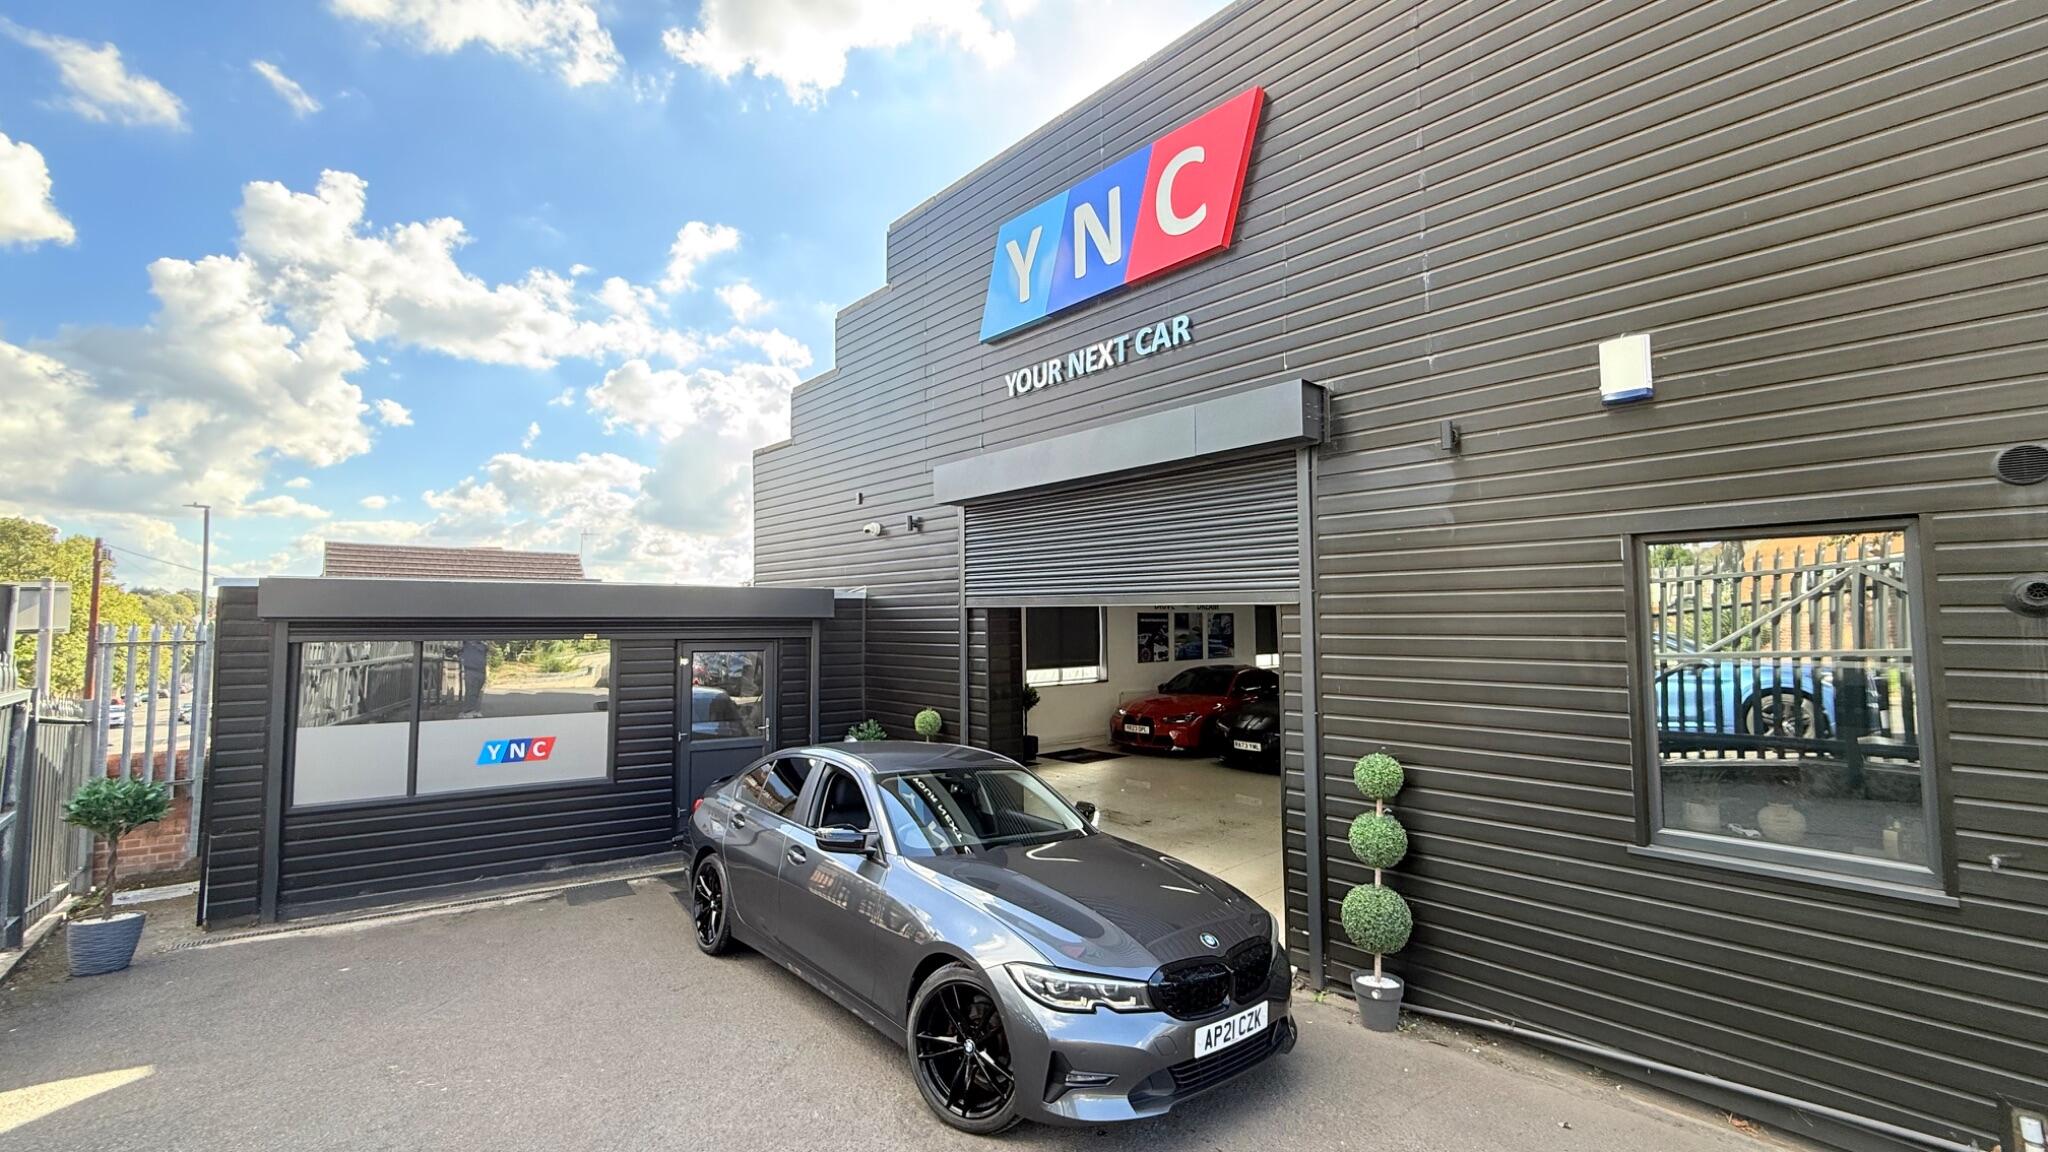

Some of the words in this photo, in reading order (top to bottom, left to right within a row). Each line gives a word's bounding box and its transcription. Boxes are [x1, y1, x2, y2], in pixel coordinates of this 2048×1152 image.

[1005, 146, 1207, 303] YNC
[1004, 358, 1062, 397] YOUR
[1067, 334, 1130, 378] NEXT
[1134, 315, 1193, 356] CAR
[487, 741, 547, 761] YNC
[1204, 1022, 1235, 1050] AP21
[1238, 1008, 1262, 1035] CZK
